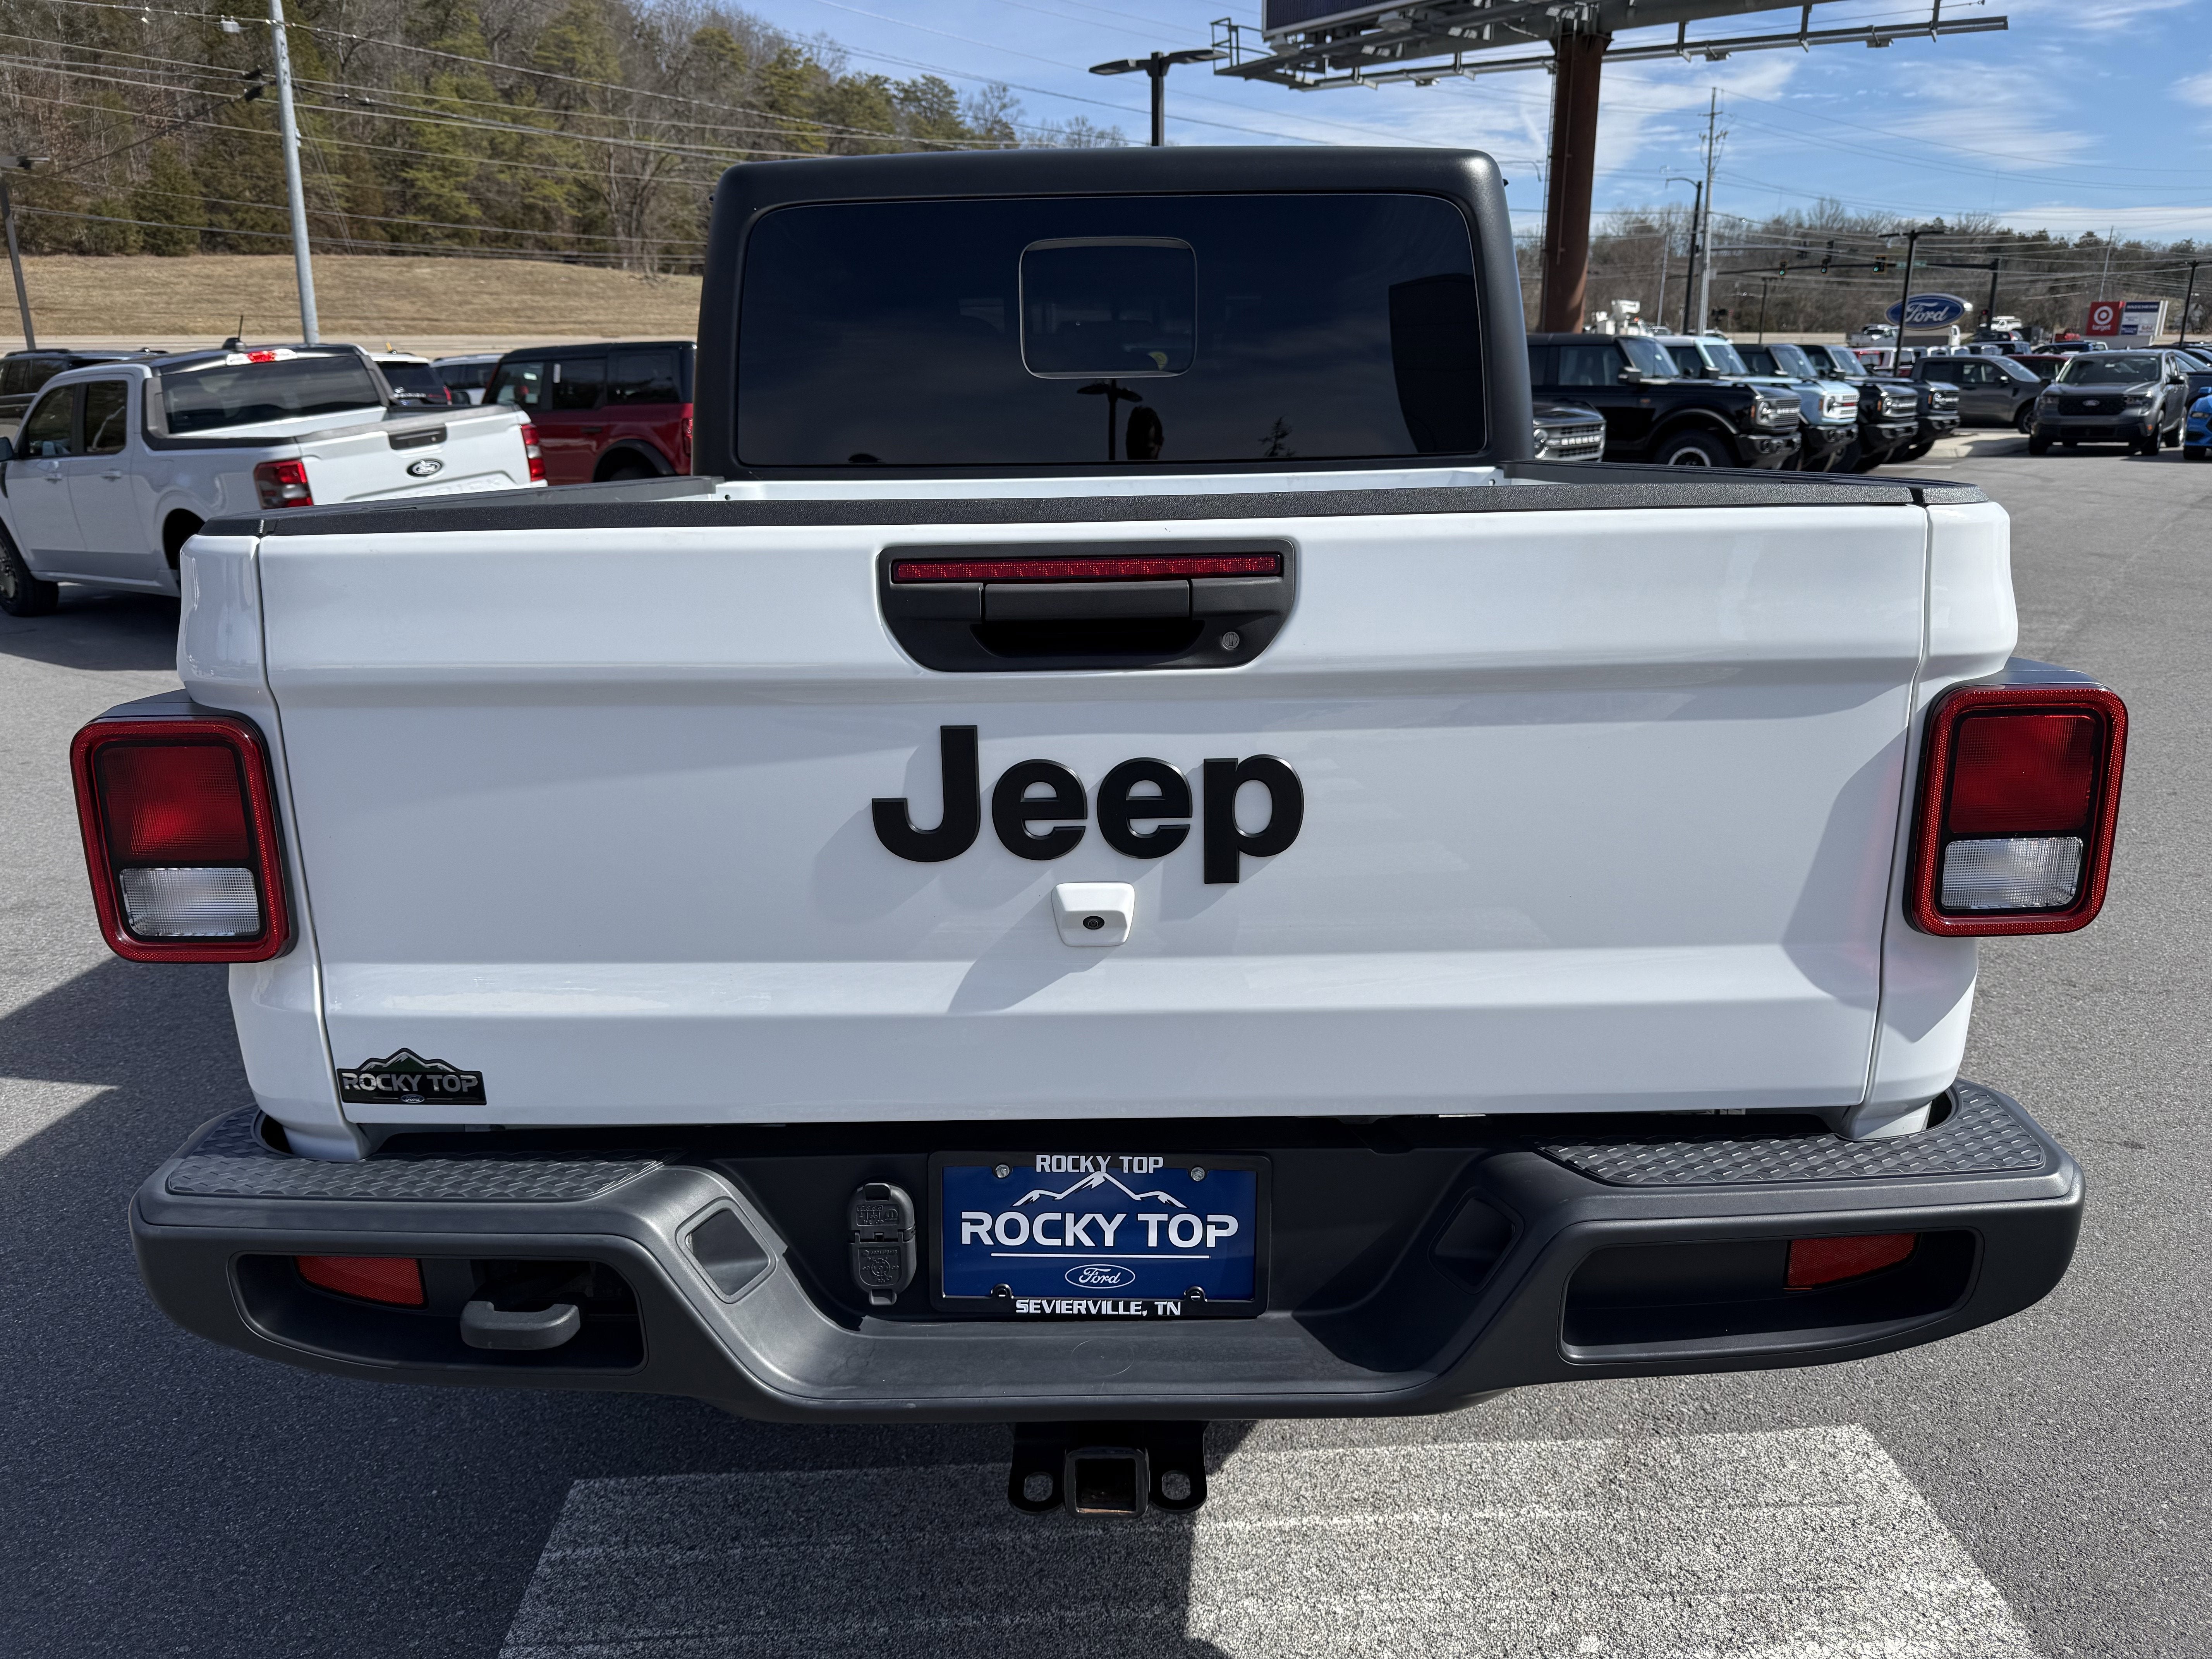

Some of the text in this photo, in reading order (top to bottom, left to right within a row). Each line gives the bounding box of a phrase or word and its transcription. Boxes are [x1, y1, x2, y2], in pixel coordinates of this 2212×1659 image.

[1905, 302, 1950, 323] Ford
[871, 725, 1304, 884] Jeep
[342, 1073, 478, 1092] ROCKY TOP
[1036, 1155, 1163, 1173] ROCKY TOP
[962, 1211, 1238, 1248] ROCKY TOP
[1079, 1267, 1121, 1283] Ford
[1016, 1300, 1181, 1316] SEVIERVILLE, TN
